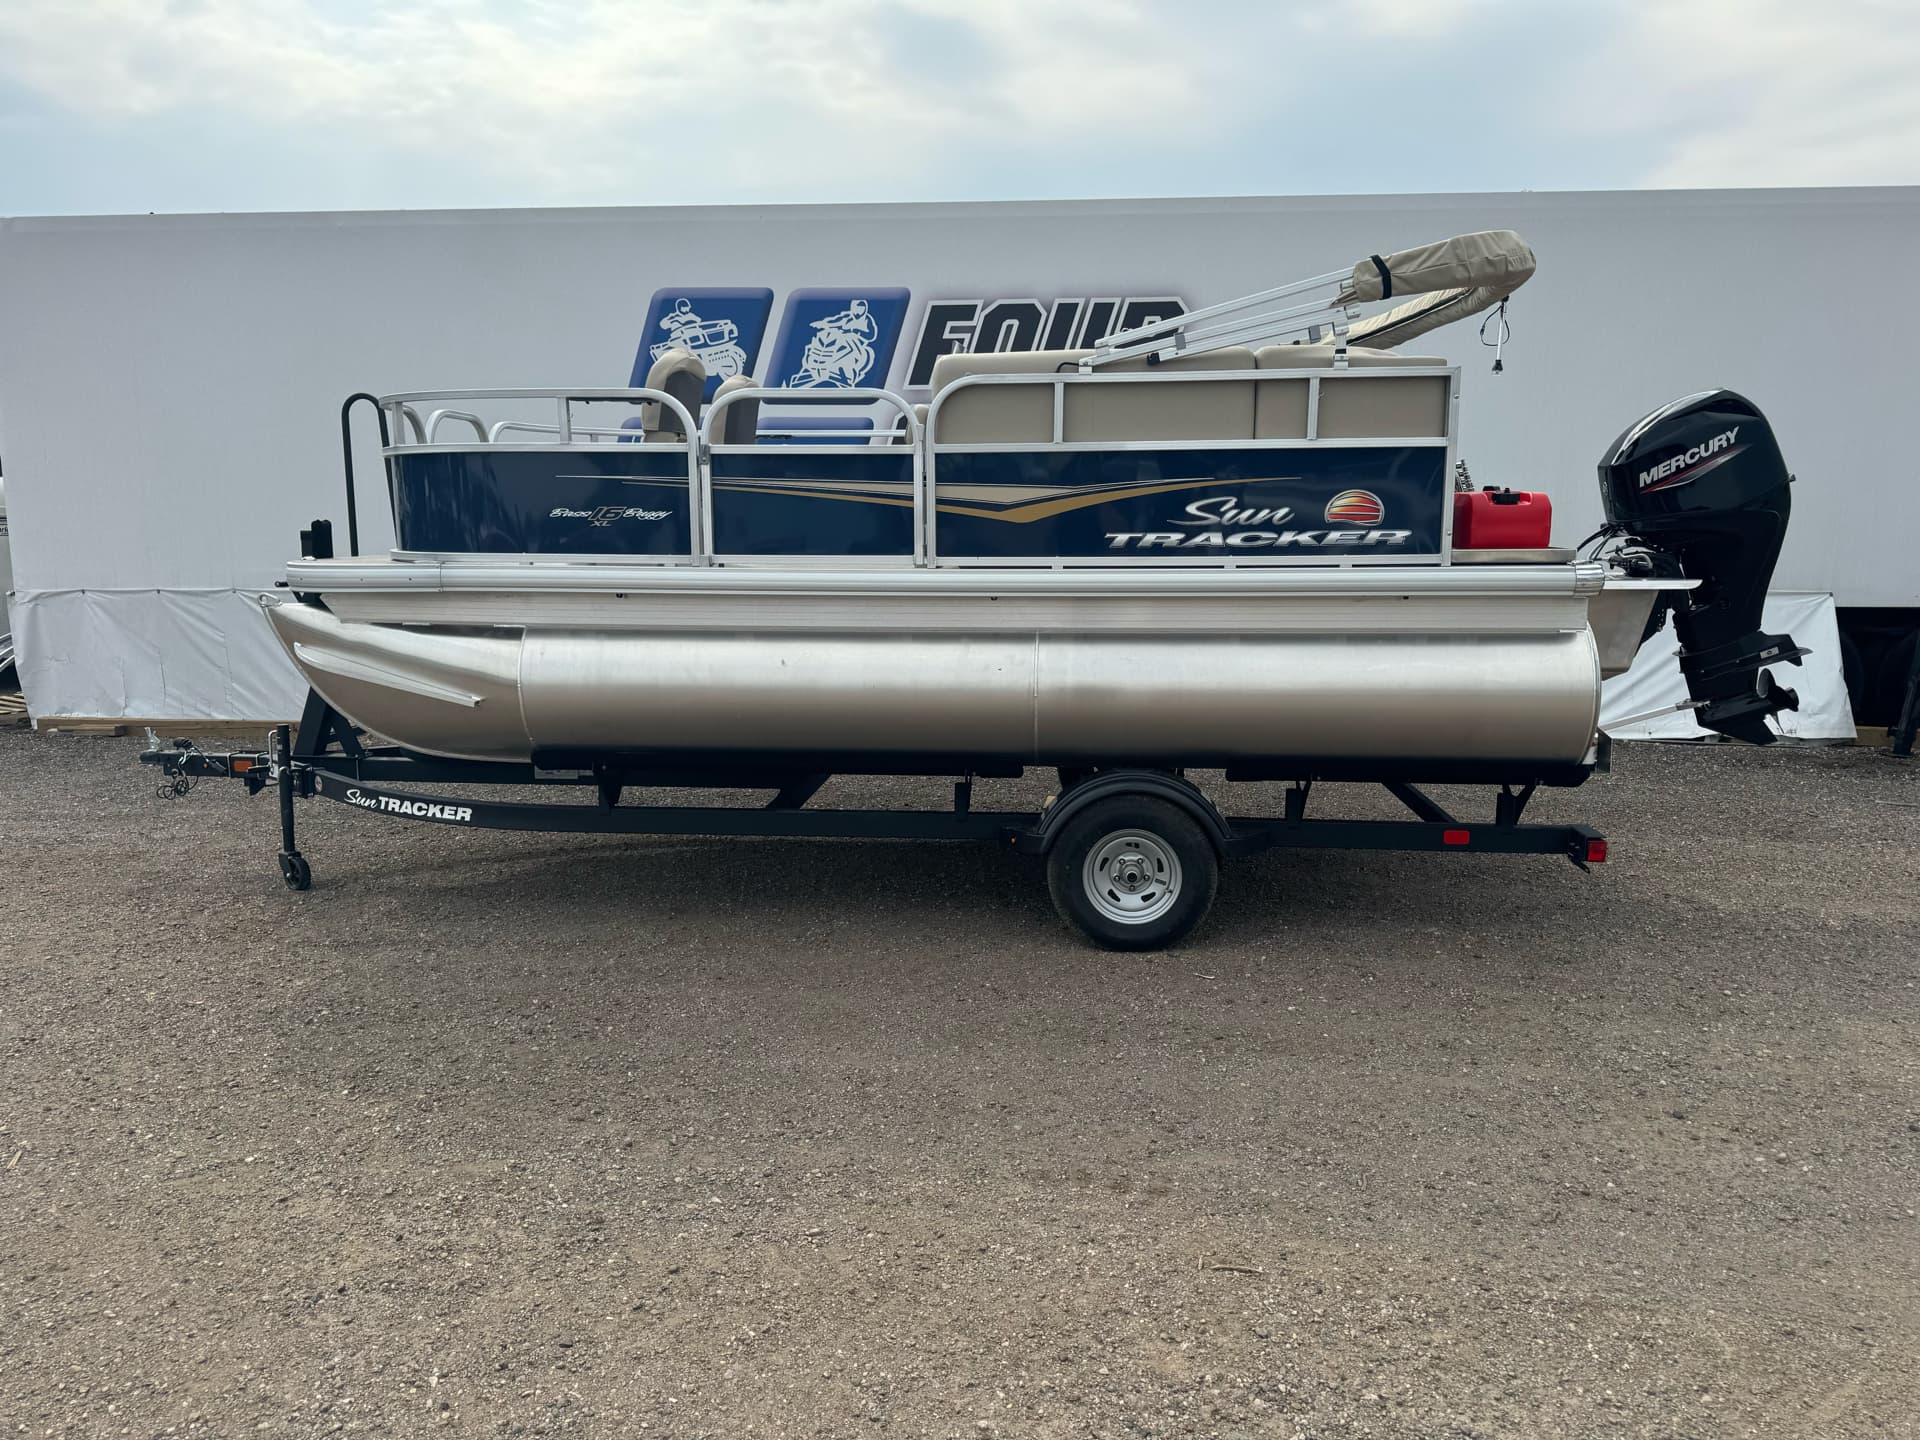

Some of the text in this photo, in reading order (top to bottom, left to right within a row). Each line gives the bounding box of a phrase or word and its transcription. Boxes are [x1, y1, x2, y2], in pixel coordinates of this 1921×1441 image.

[1639, 426, 1740, 487] MERCURY
[588, 506, 627, 521] 16
[623, 507, 673, 521] Buggy
[1166, 496, 1295, 526] Sun
[1104, 529, 1413, 548] TRACKER
[344, 788, 473, 822] Sun TRACKER
